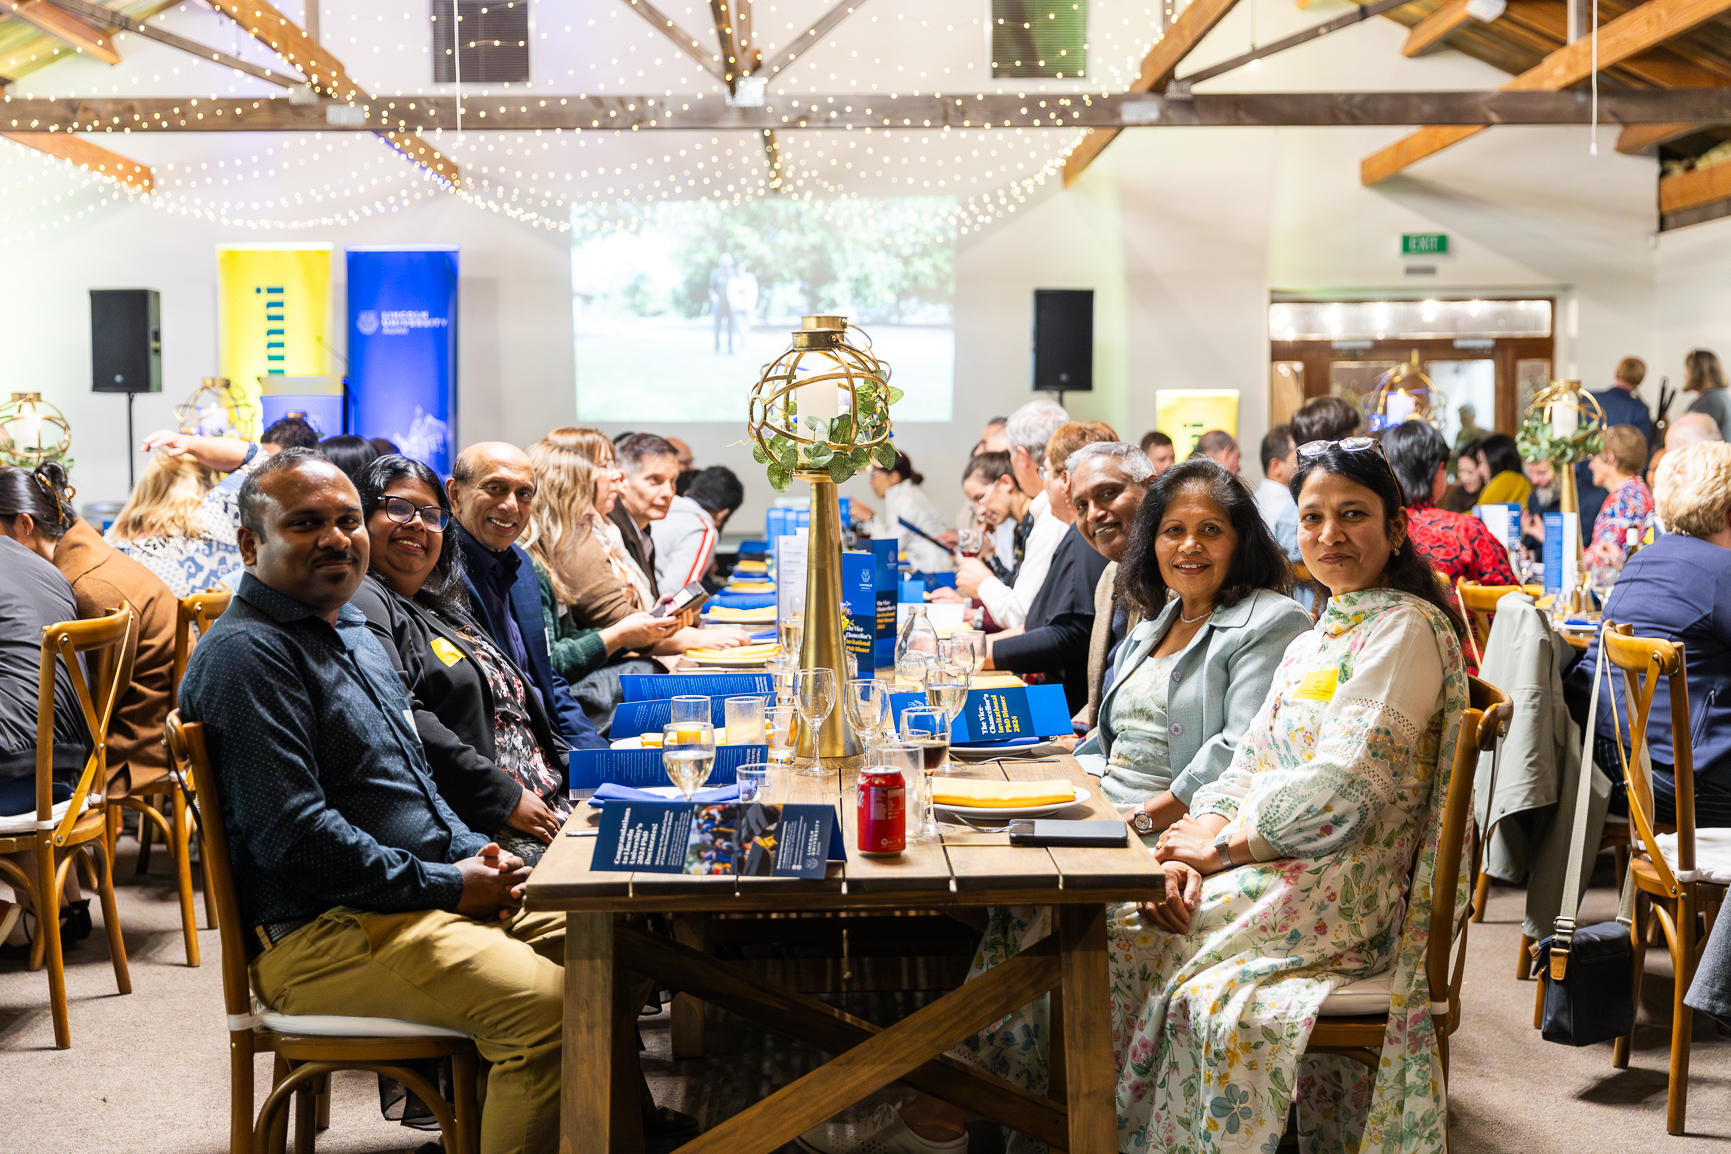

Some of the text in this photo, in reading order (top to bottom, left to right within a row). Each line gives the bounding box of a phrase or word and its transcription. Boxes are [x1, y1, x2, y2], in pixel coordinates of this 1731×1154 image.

[1409, 236, 1438, 251] EXIT
[978, 704, 986, 721] Vice-
[983, 693, 996, 734] Chancellor's
[990, 695, 1004, 733] Invitational
[1000, 695, 1012, 733] PhD Dinner
[1011, 716, 1020, 732] 2024
[614, 807, 631, 864] Congratulations
[621, 829, 635, 865] to Lincoln
[629, 822, 643, 865] University's
[637, 830, 649, 865] 2024 PhD
[644, 823, 658, 865] Doctorates!
[806, 830, 814, 856] LINCOLN
[811, 820, 821, 856] UNIVERSITY
